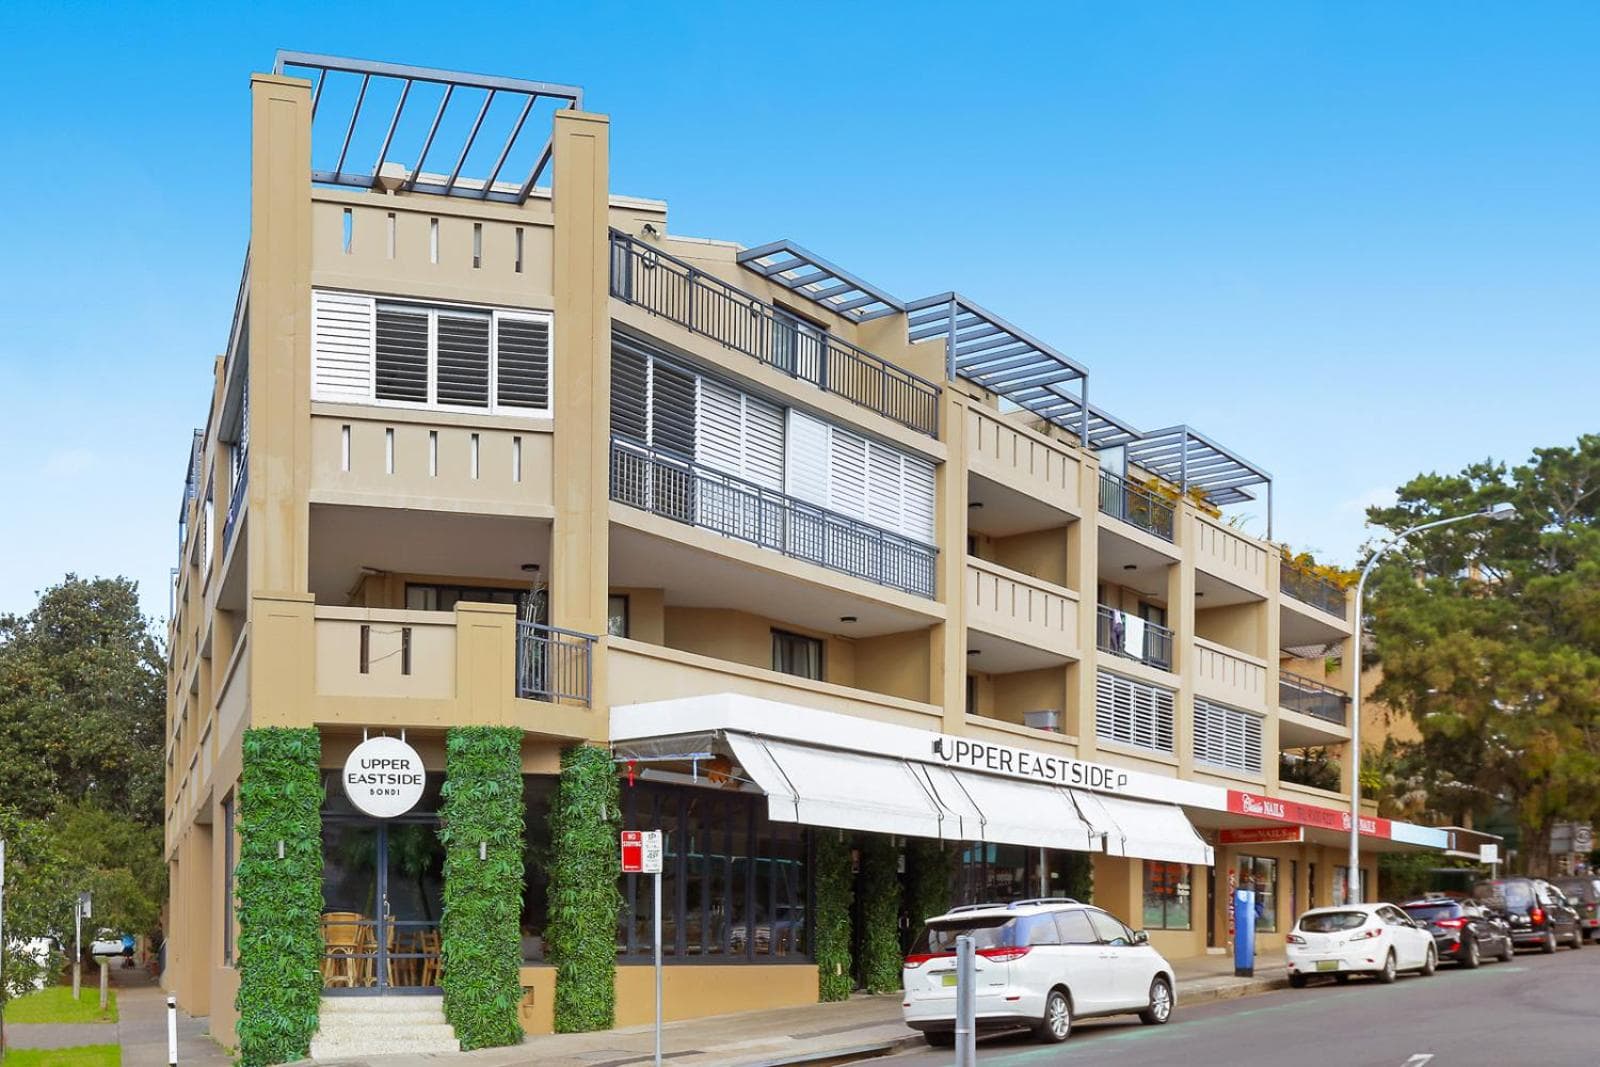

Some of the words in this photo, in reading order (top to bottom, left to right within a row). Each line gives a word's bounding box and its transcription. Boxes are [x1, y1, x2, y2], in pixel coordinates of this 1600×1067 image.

[361, 758, 410, 770] UPPER
[939, 737, 1013, 773] UPPER
[1018, 751, 1114, 790] EASTSIDE
[348, 773, 422, 785] EASTSIDE
[369, 788, 400, 796] BONDI
[1263, 801, 1284, 818] NAILS
